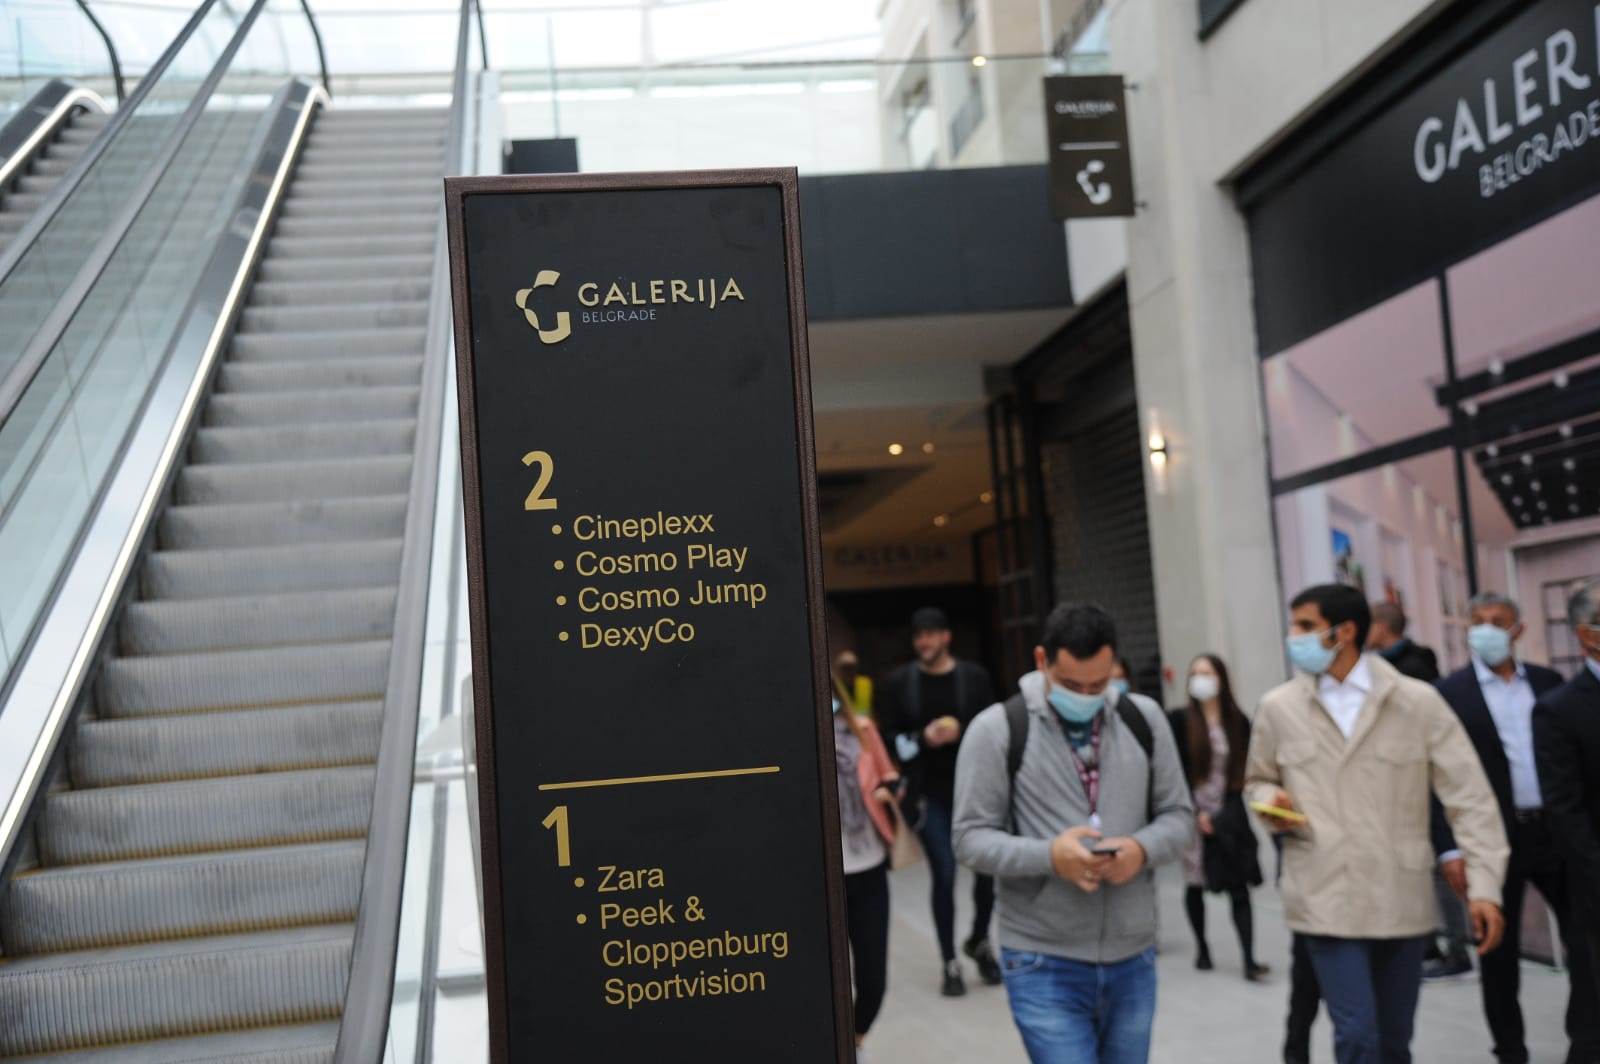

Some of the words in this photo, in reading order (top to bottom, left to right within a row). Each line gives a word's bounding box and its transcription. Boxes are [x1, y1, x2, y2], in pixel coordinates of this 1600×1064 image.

[1478, 99, 1600, 198] BELGRADE
[577, 277, 745, 309] GALERIJA
[582, 309, 657, 323] BELGRADE
[521, 450, 558, 511] 2
[573, 510, 715, 543] Cineplexx
[575, 550, 678, 577] Cosmo
[687, 543, 748, 573] Play
[578, 586, 680, 613] Cosmo
[689, 579, 767, 609] Jump
[580, 617, 695, 652] DexyCo
[541, 805, 571, 867] 1
[597, 865, 665, 893] Zara
[600, 898, 675, 930] Peek
[684, 895, 706, 922] &
[602, 930, 789, 970] Cloppenburg
[605, 968, 766, 1010] Sportvision
